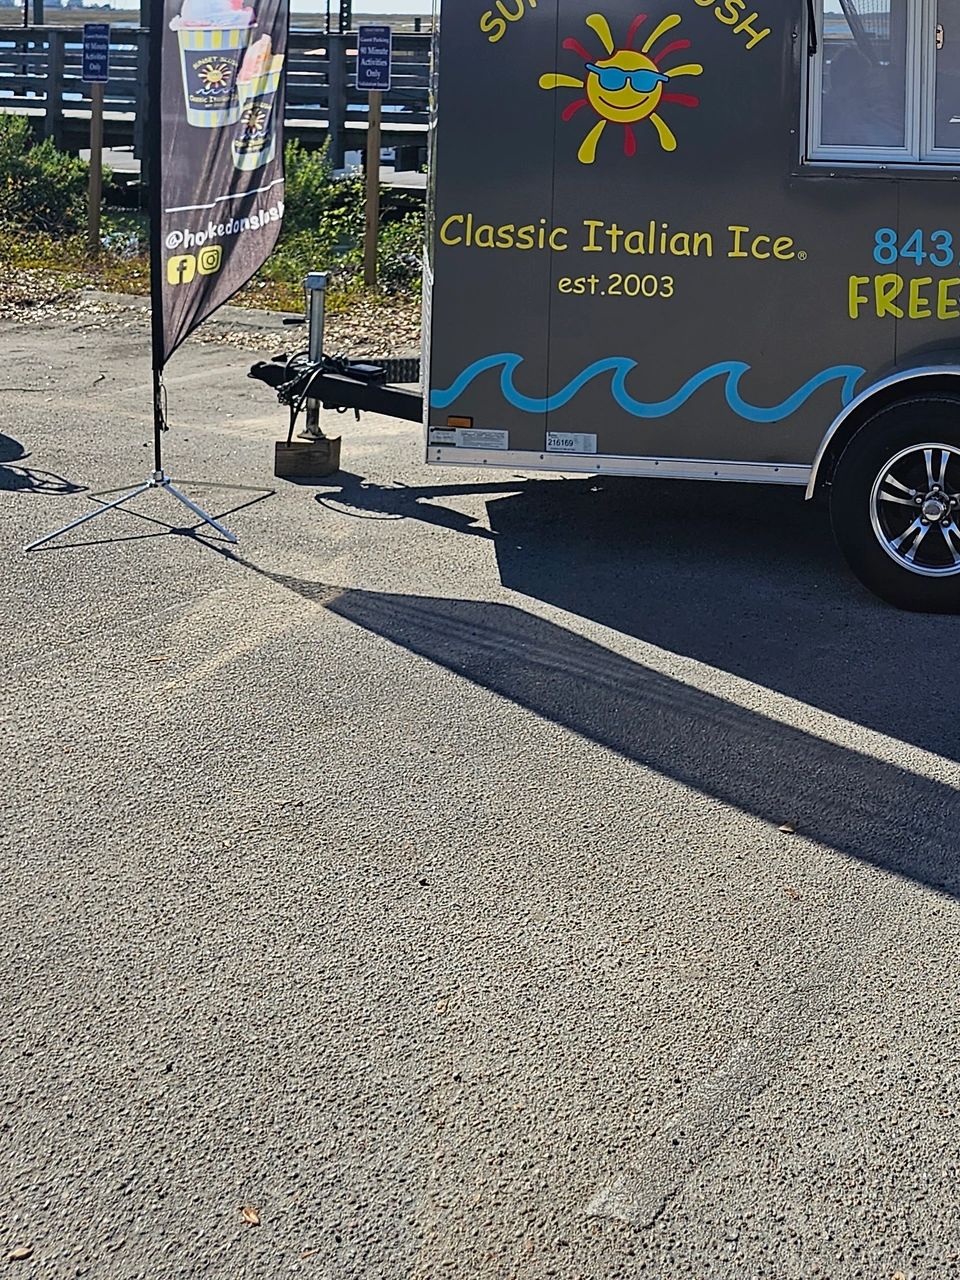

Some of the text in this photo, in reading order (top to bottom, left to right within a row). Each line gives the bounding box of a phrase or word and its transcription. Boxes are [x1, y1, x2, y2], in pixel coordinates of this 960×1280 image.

[439, 214, 568, 252] Classic
[582, 219, 713, 258] Italian
[557, 273, 675, 298] est.2003
